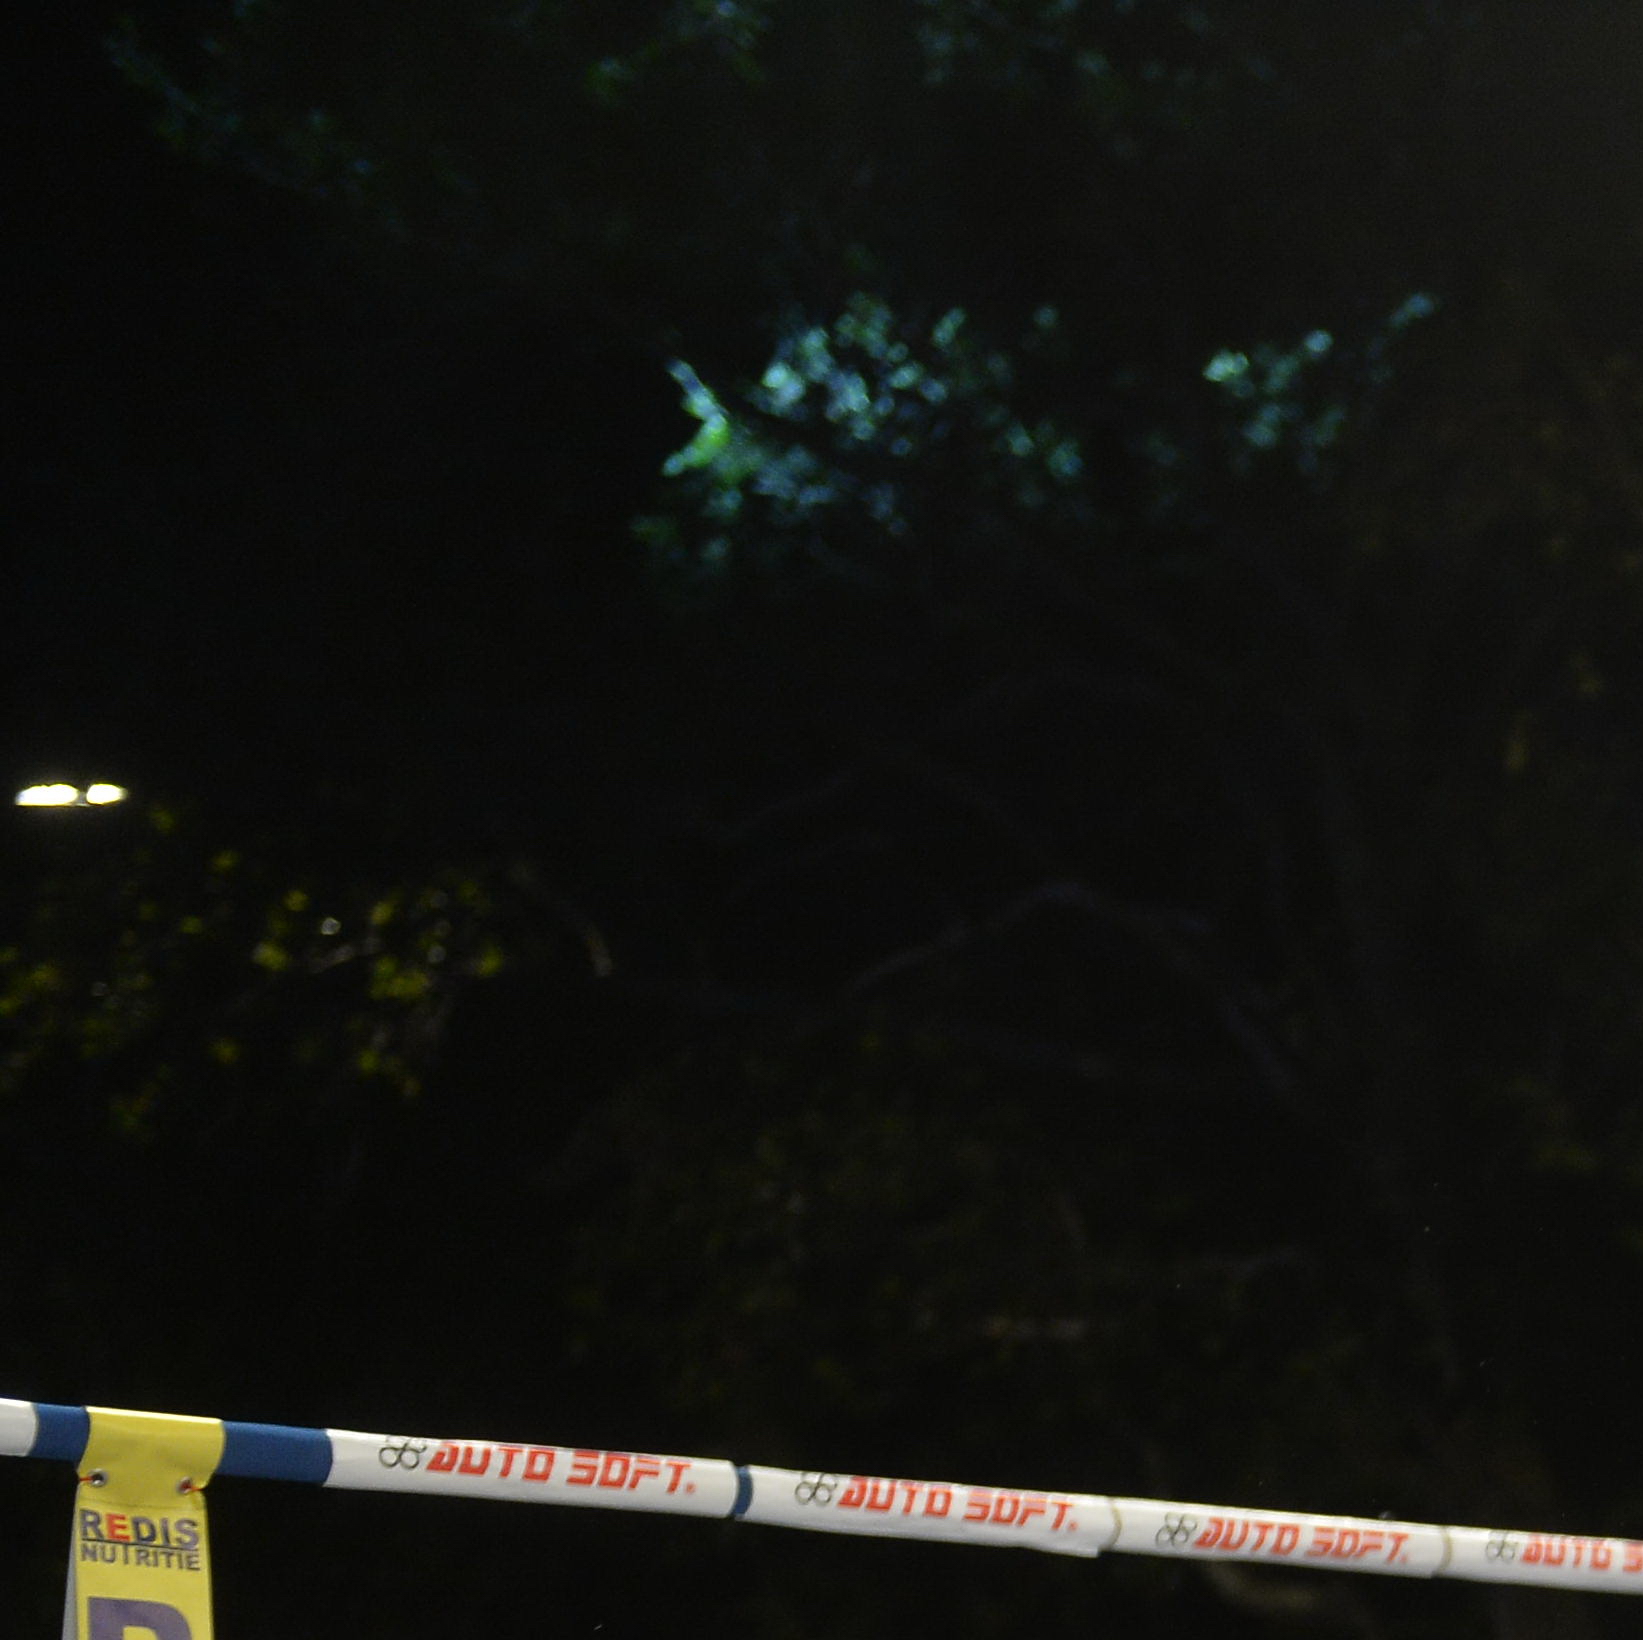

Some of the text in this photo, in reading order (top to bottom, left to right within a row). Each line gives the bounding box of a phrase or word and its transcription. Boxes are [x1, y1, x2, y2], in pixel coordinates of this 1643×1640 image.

[426, 1441, 556, 1483] AUTO
[837, 1475, 953, 1519] AUTO
[78, 1508, 200, 1551] REDIS
[1195, 1517, 1300, 1557] AUTO
[80, 1543, 201, 1573] NUTRITIE
